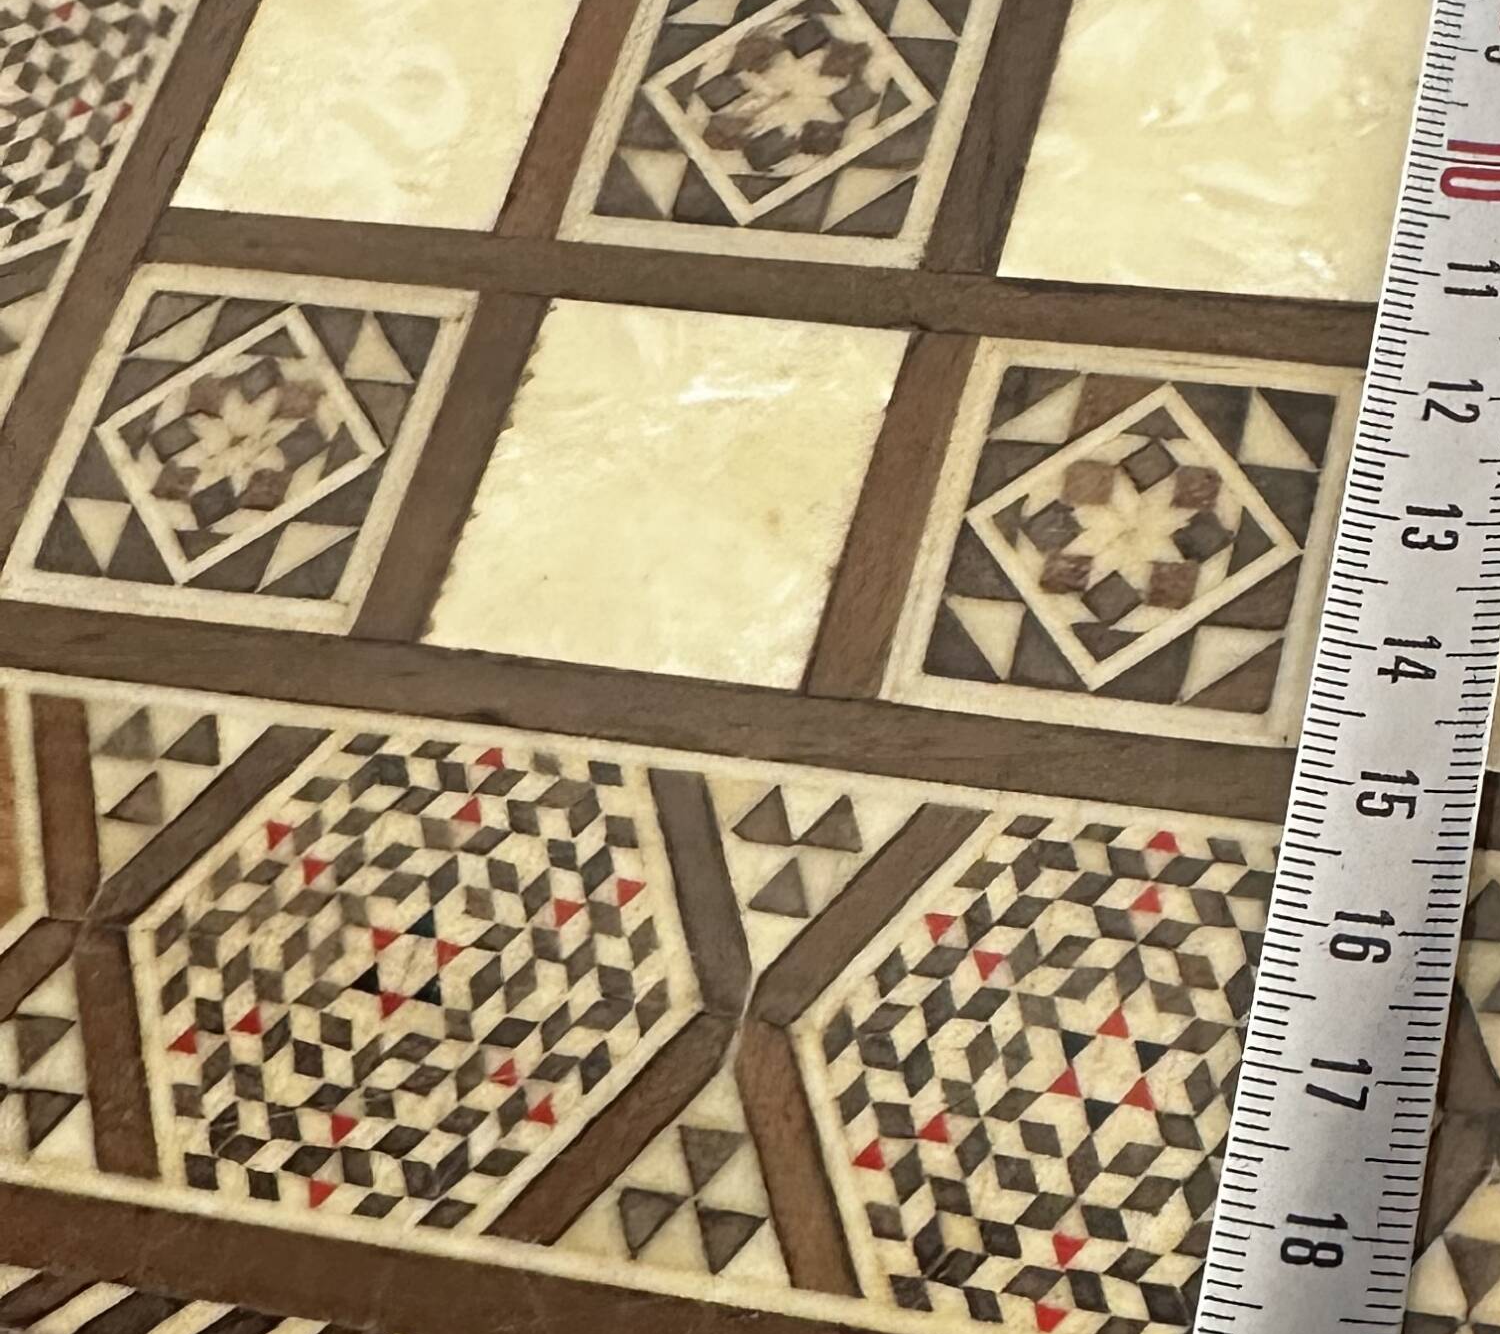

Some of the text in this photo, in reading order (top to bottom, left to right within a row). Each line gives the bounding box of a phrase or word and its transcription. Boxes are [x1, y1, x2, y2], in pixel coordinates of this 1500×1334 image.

[1421, 379, 1484, 424] 12
[1401, 503, 1463, 551] 13
[1377, 635, 1442, 683] 14
[1356, 769, 1420, 819] 15
[1329, 910, 1395, 964] 16
[1306, 1058, 1373, 1110] 17
[1280, 1213, 1348, 1268] 18
